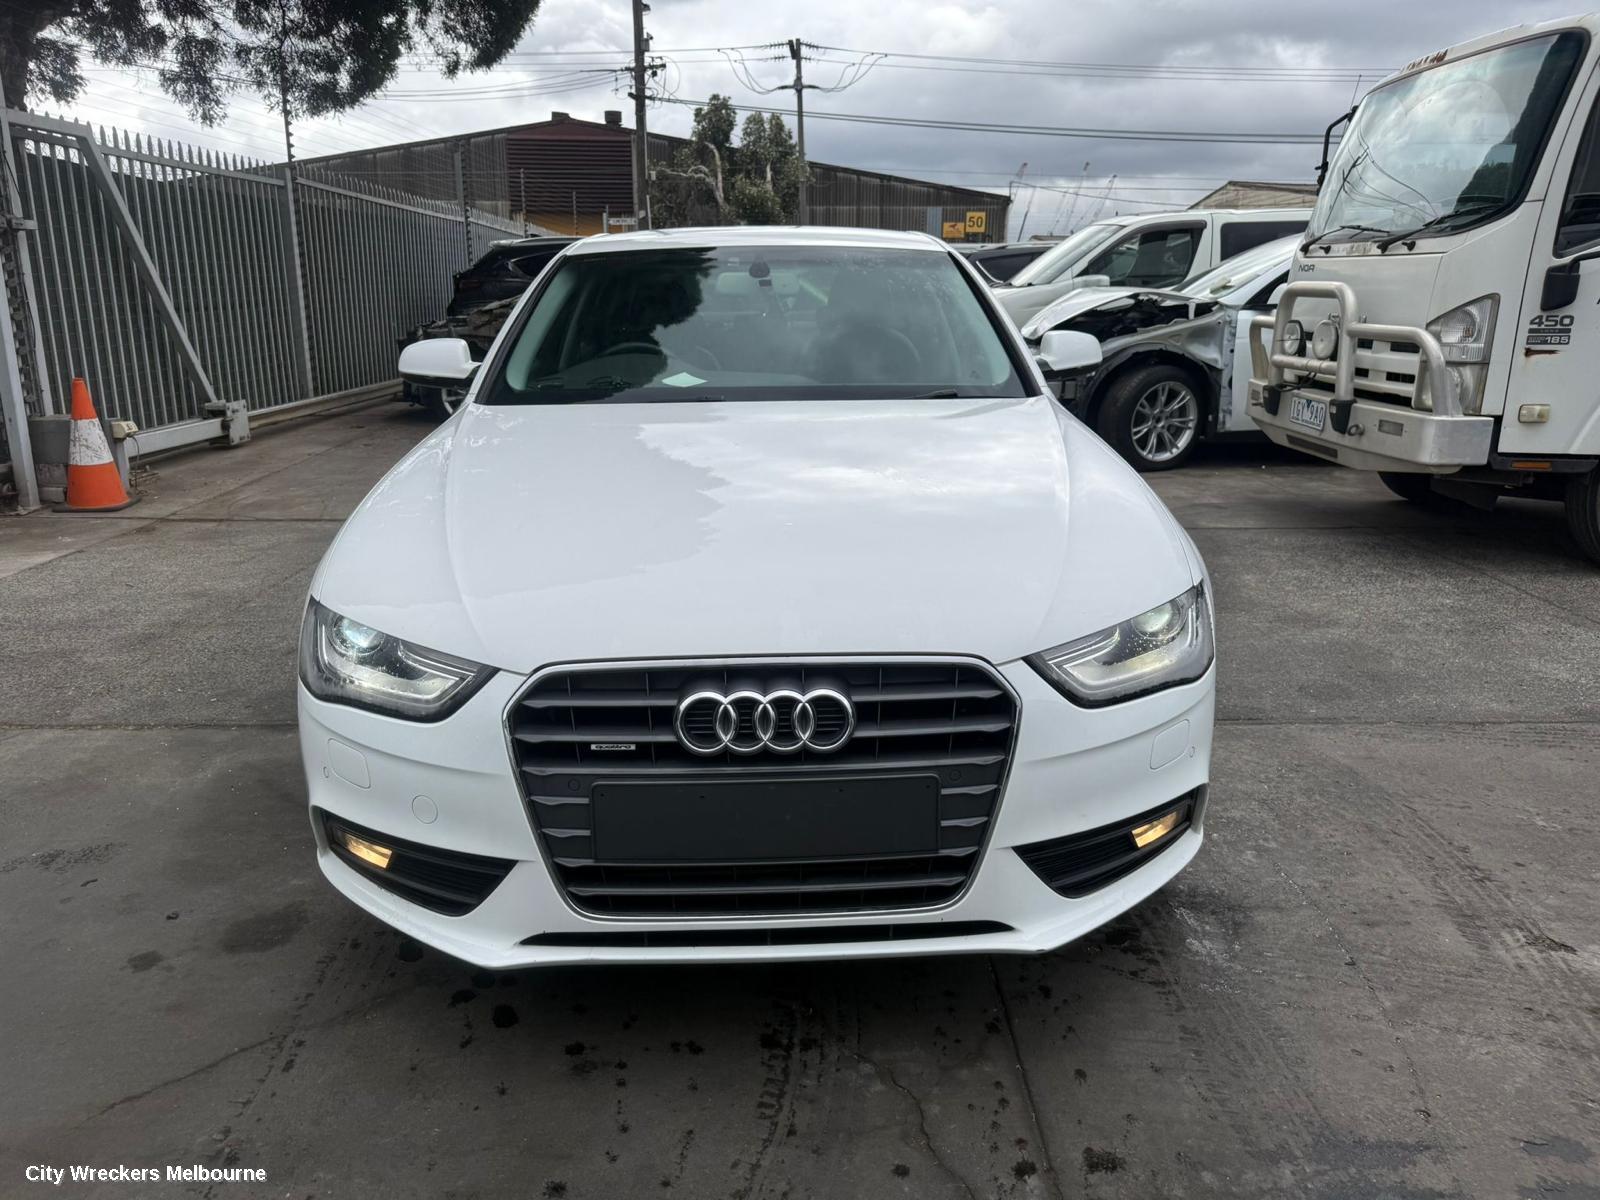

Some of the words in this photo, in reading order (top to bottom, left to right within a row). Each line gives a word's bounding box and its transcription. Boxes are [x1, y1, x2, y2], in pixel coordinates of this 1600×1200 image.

[967, 216, 984, 228] 50
[1529, 314, 1575, 328] 450
[1545, 336, 1569, 344] 185
